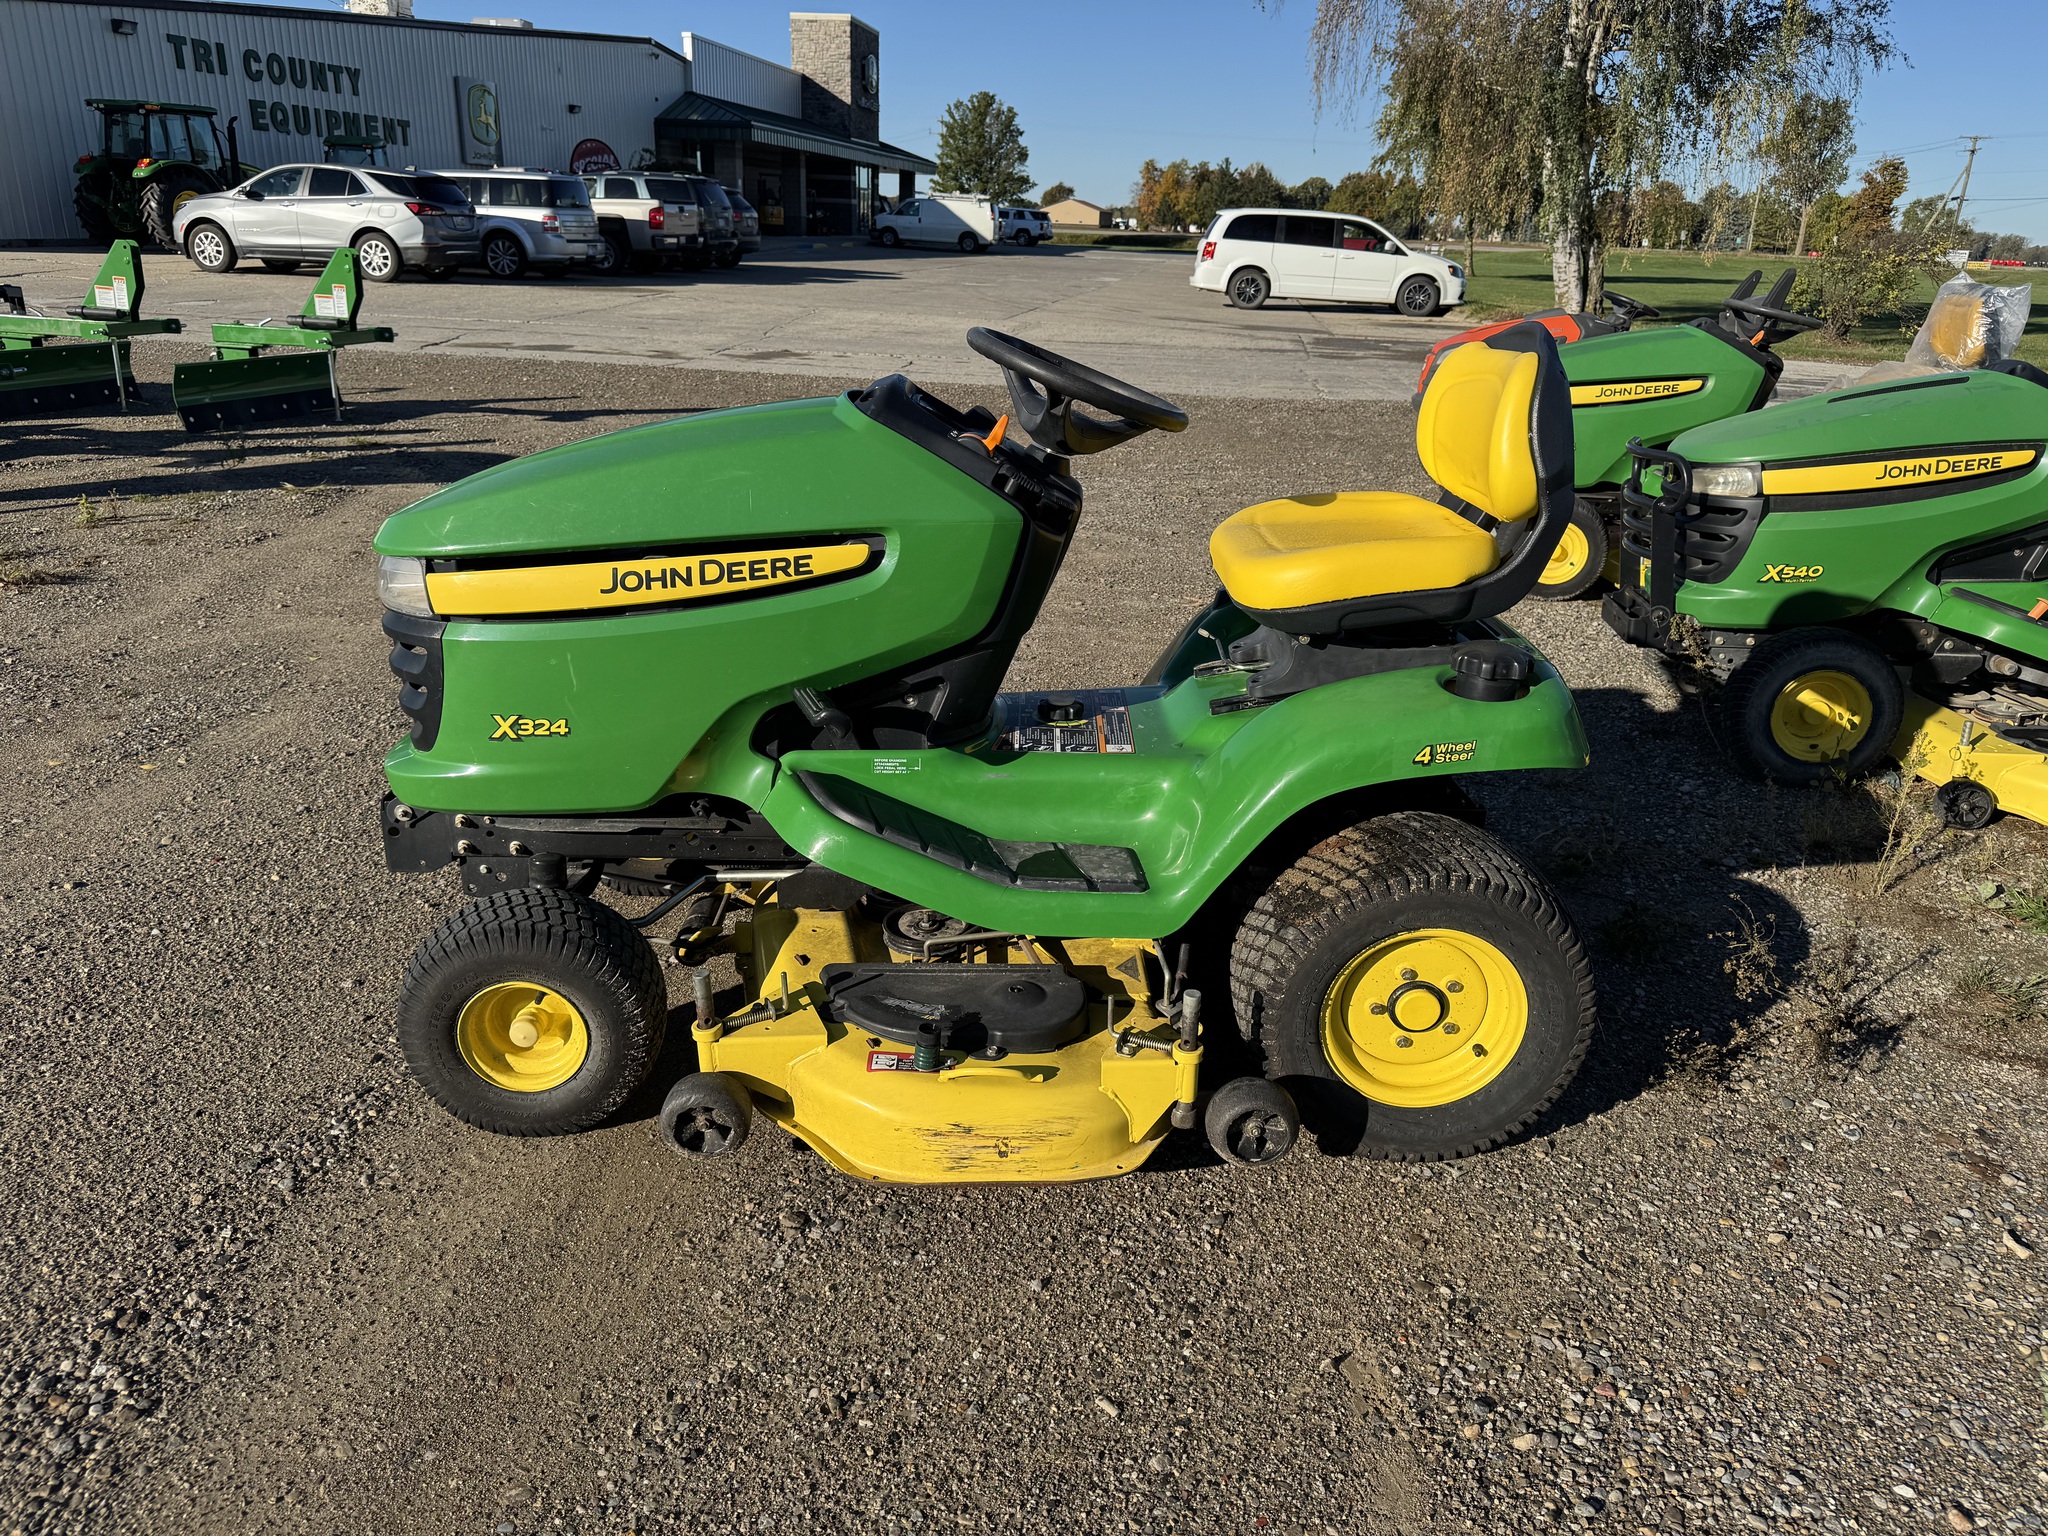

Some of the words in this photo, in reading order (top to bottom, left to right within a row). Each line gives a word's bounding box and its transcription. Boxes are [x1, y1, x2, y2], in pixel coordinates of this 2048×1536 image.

[166, 33, 228, 75] TRI
[243, 49, 361, 96] COUNTY
[248, 99, 411, 146] EQUIPMENT
[1596, 387, 1632, 398] JOHN
[1634, 384, 1679, 395] DEERE
[1875, 463, 1932, 480] JOHN
[1935, 456, 2003, 474] DEERE
[600, 566, 693, 594] JOHN
[699, 554, 814, 586] DEERE
[1757, 564, 1824, 582] X540
[489, 714, 571, 741] X324
[1413, 745, 1433, 766] 4
[1436, 740, 1477, 753] Wheel
[1435, 752, 1475, 764] Steer
[1532, 981, 1565, 1080] CARLISLE
[580, 1008, 612, 1099] CARLISLE
